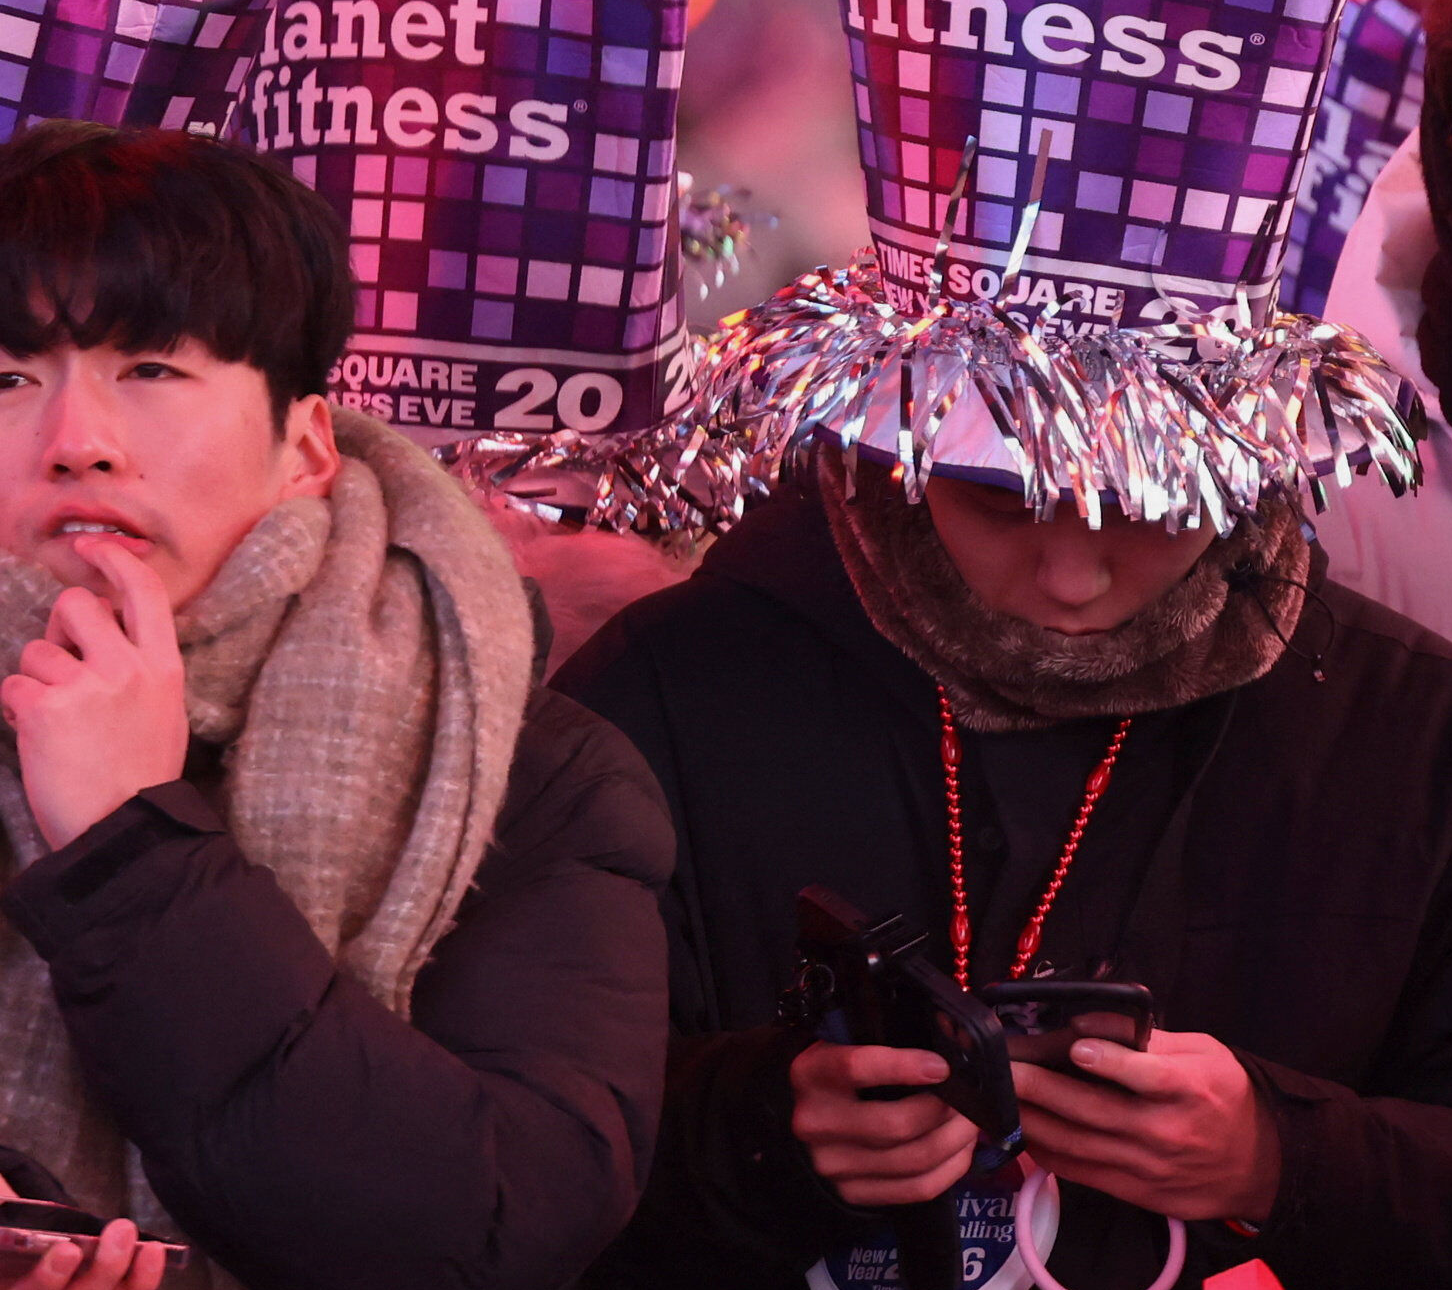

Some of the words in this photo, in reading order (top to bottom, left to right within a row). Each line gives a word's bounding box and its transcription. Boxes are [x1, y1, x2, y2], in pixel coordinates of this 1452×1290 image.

[252, 66, 571, 161] fitness
[948, 263, 1119, 318] SQUARE
[398, 395, 476, 427] EVE
[850, 1246, 887, 1265] New
[847, 1263, 883, 1281] Year
